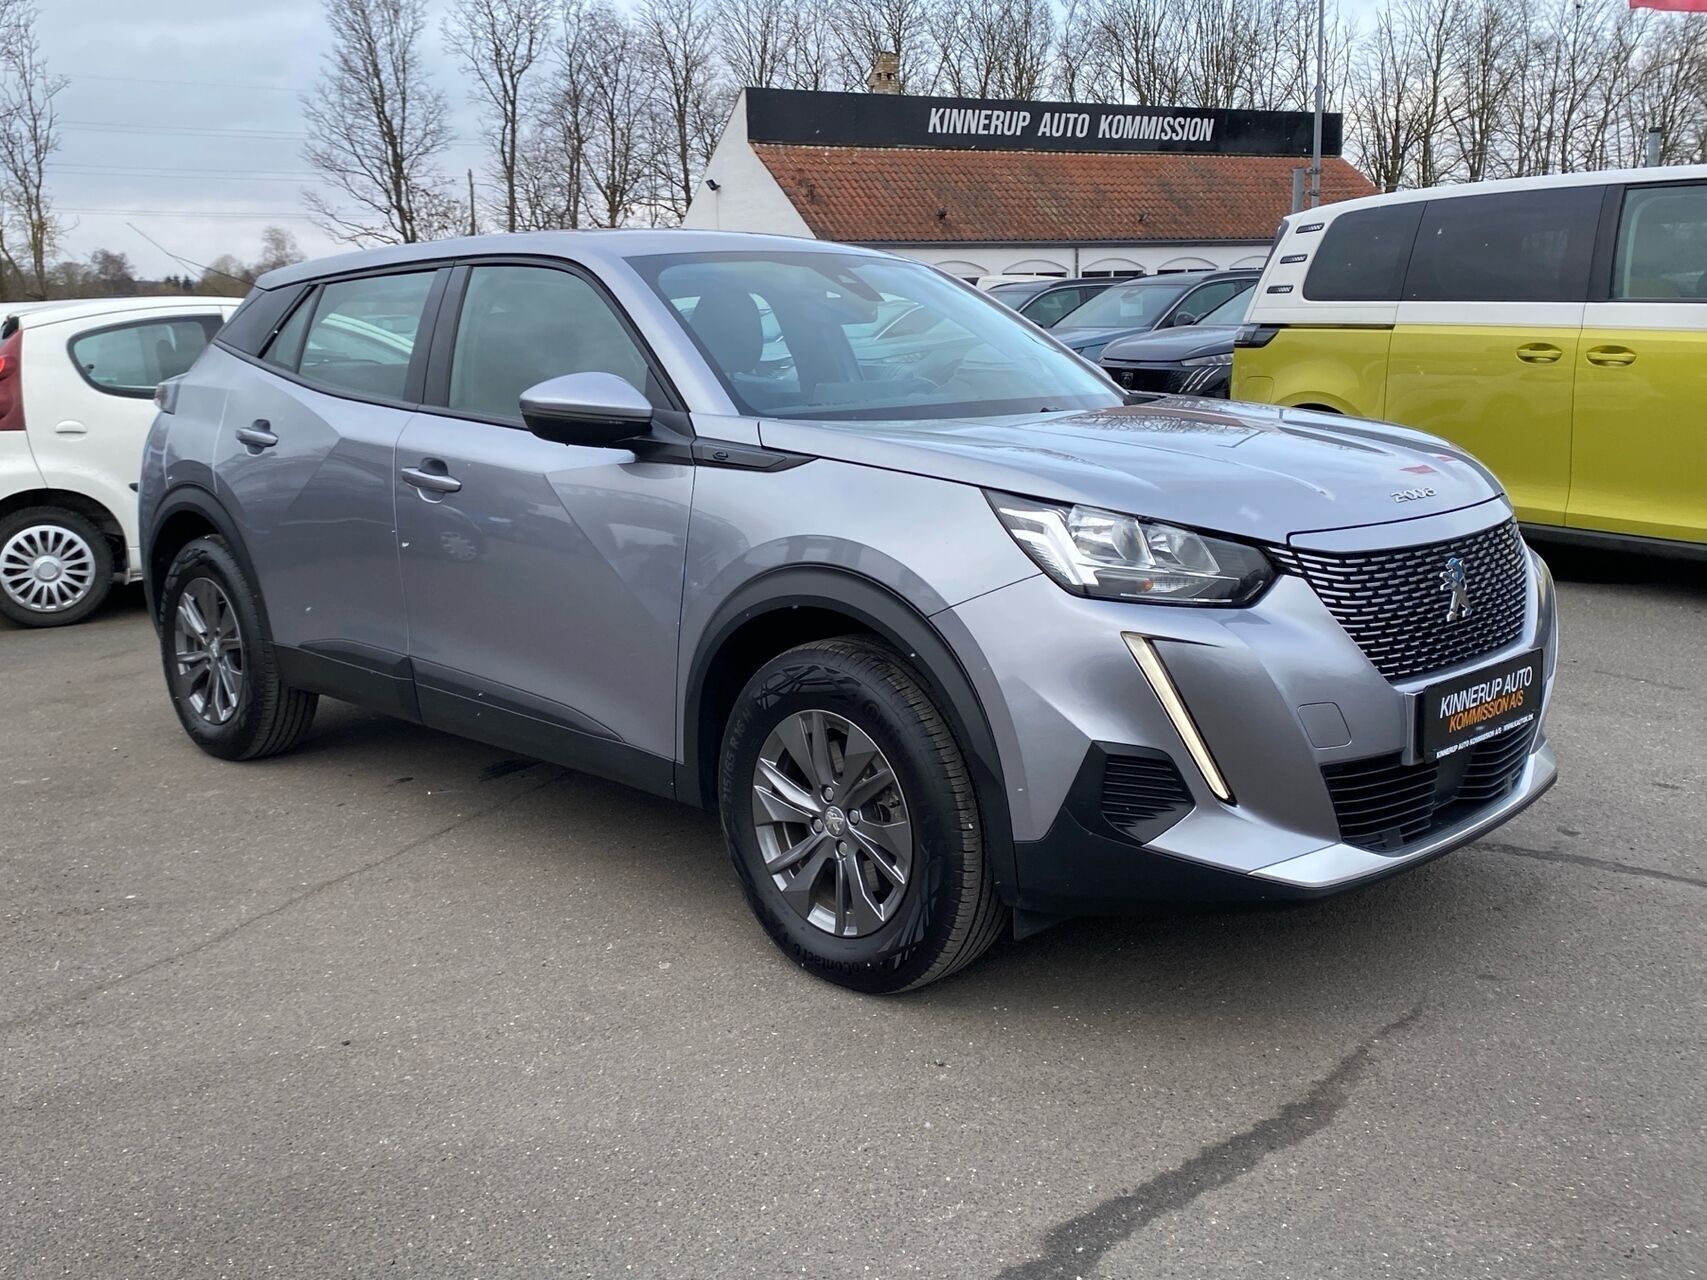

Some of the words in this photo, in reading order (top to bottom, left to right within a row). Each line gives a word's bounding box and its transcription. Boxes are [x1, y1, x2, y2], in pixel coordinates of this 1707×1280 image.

[928, 107, 1031, 136] KINNERUP
[1037, 112, 1090, 138] AUTO
[1098, 114, 1215, 142] KOMMISSION
[1390, 487, 1437, 503] 2008
[1440, 677, 1503, 719] KINNERUP
[1502, 666, 1533, 696] AUTO
[1448, 695, 1510, 733] KOMMISSION
[1508, 690, 1524, 710] A/S
